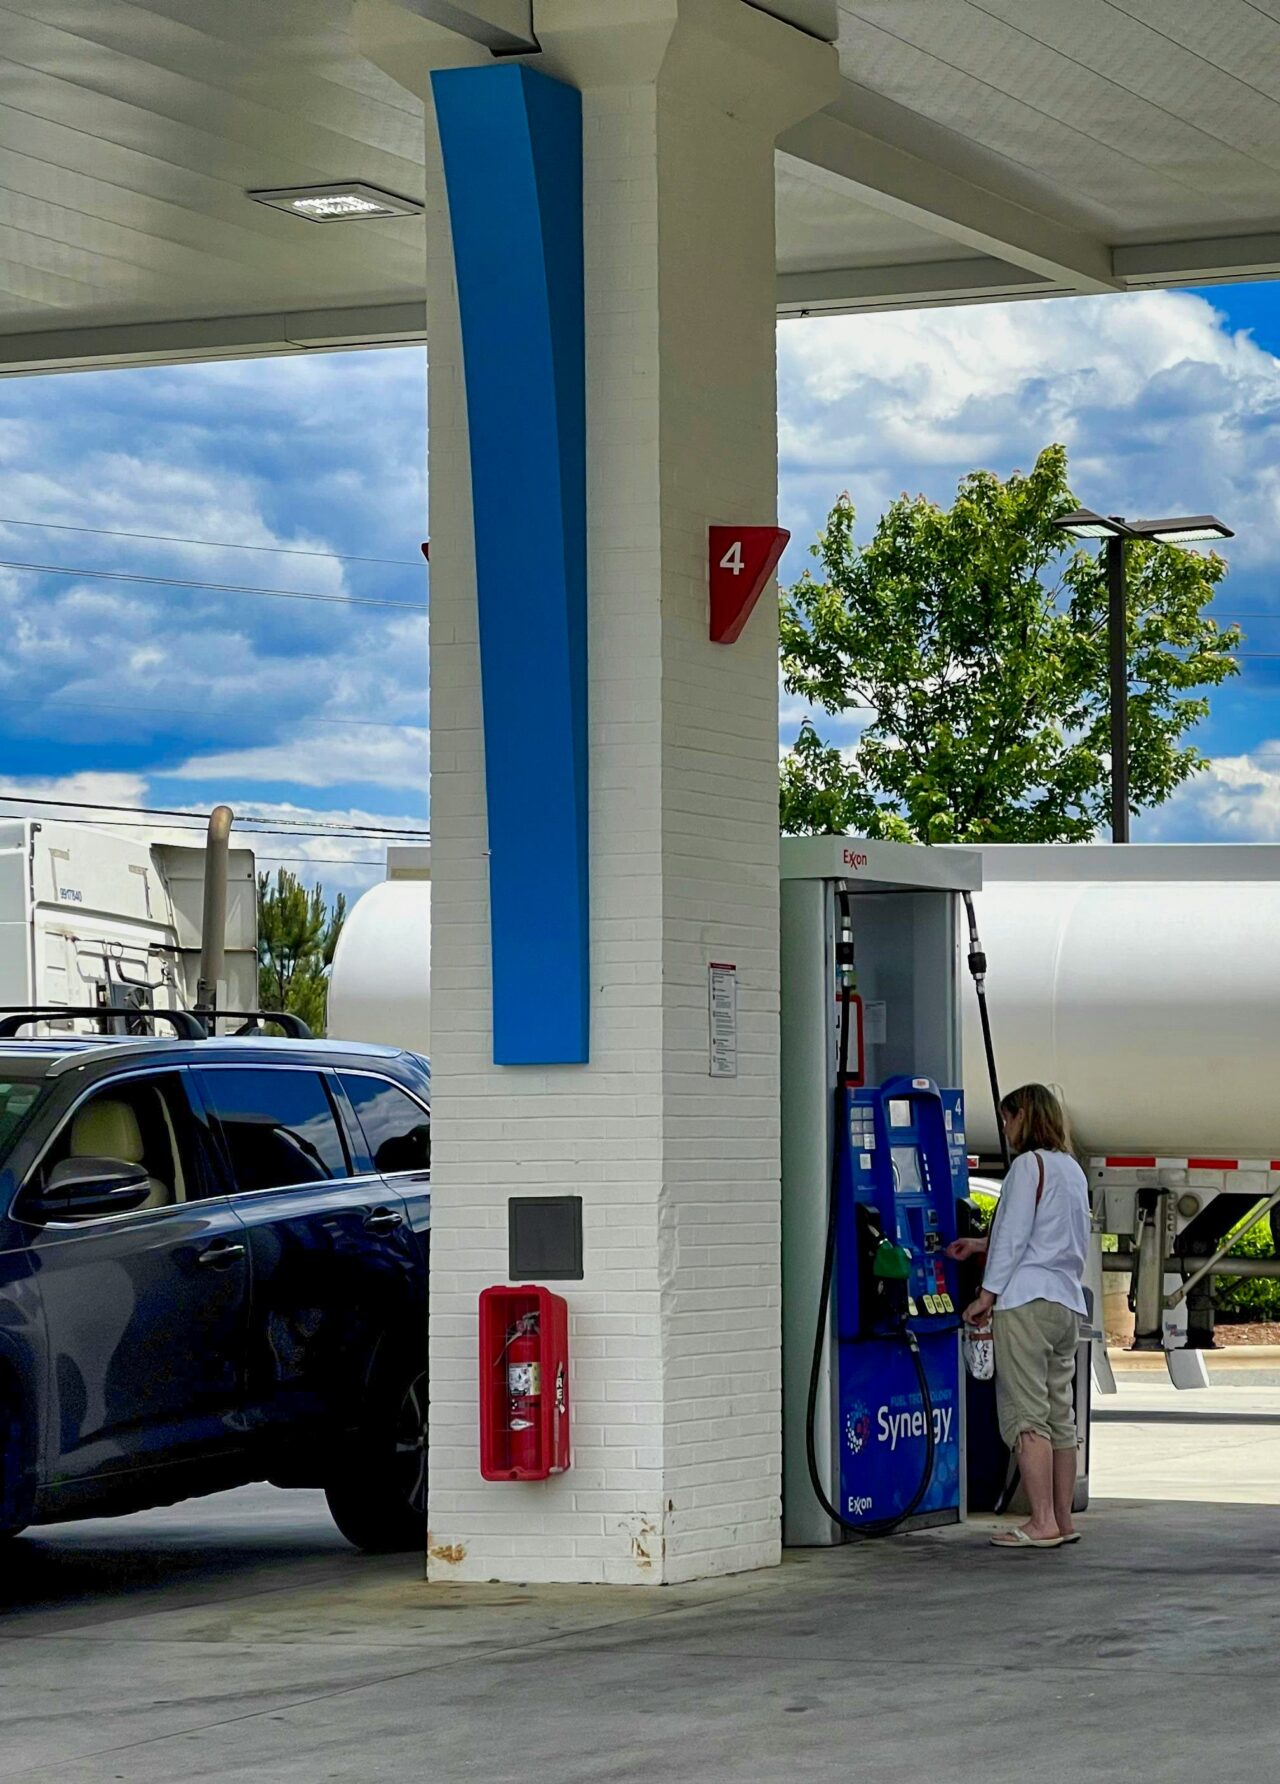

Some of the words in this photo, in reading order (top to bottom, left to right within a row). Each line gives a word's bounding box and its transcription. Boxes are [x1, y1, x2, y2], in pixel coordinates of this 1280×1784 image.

[720, 541, 744, 575] 4
[843, 849, 867, 870] Exxon
[955, 1097, 962, 1116] 4
[908, 1389, 952, 1405] TECOLOGY
[848, 1496, 872, 1516] Exxon
